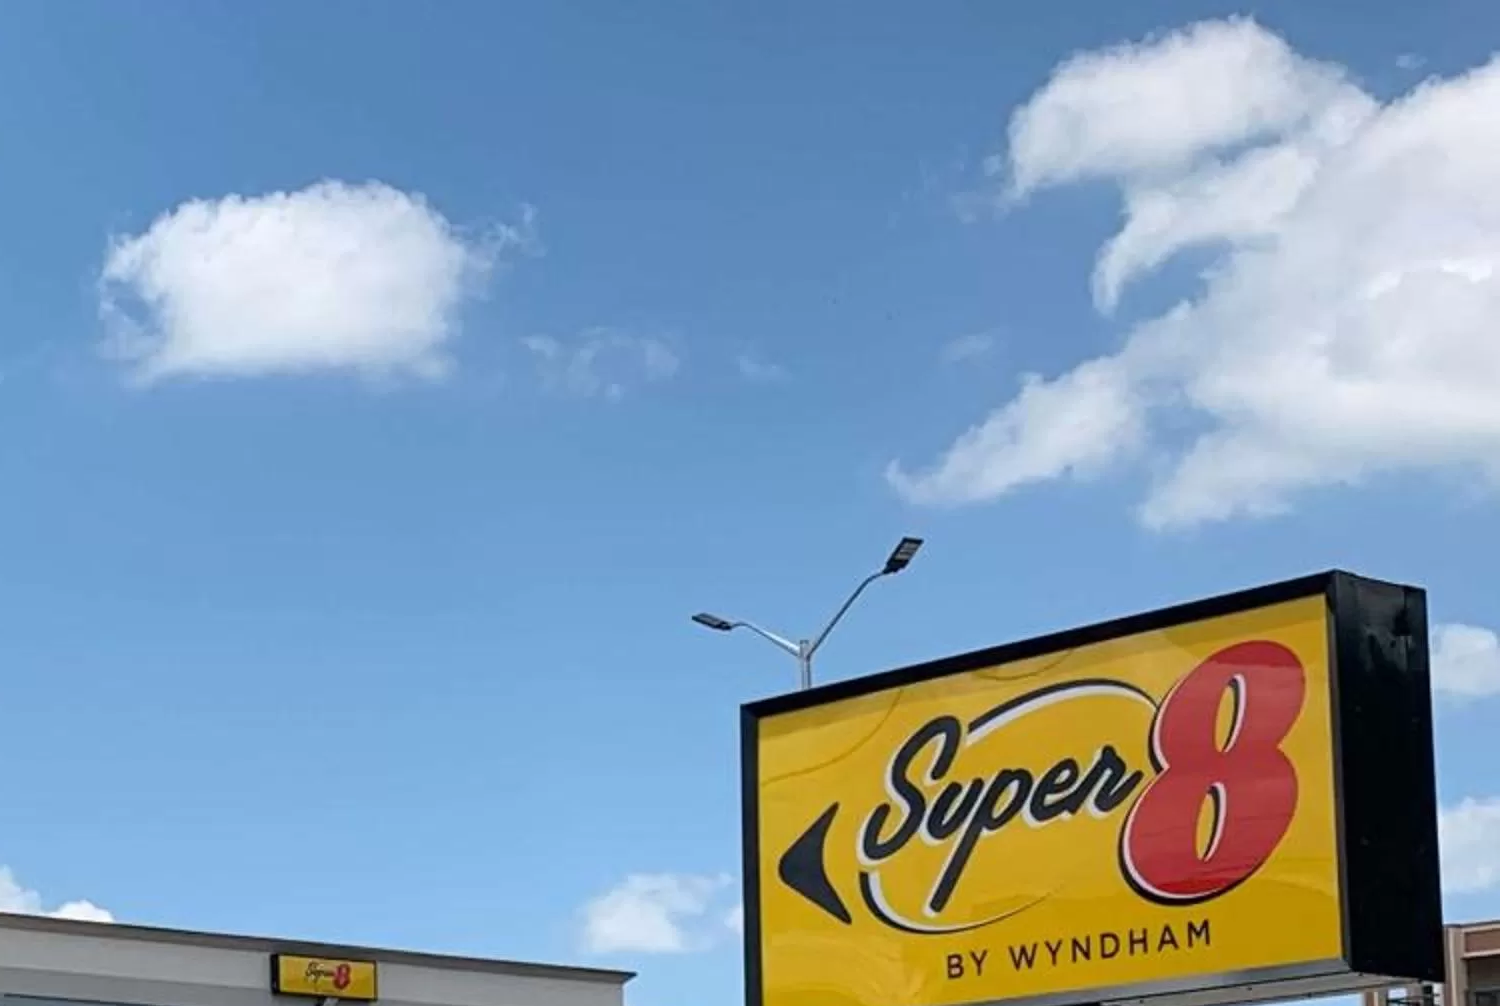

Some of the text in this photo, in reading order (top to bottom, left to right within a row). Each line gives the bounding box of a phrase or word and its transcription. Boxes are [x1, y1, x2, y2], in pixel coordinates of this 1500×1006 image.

[860, 640, 1307, 916] Super 8
[947, 919, 1211, 979] BY WYNDHAM
